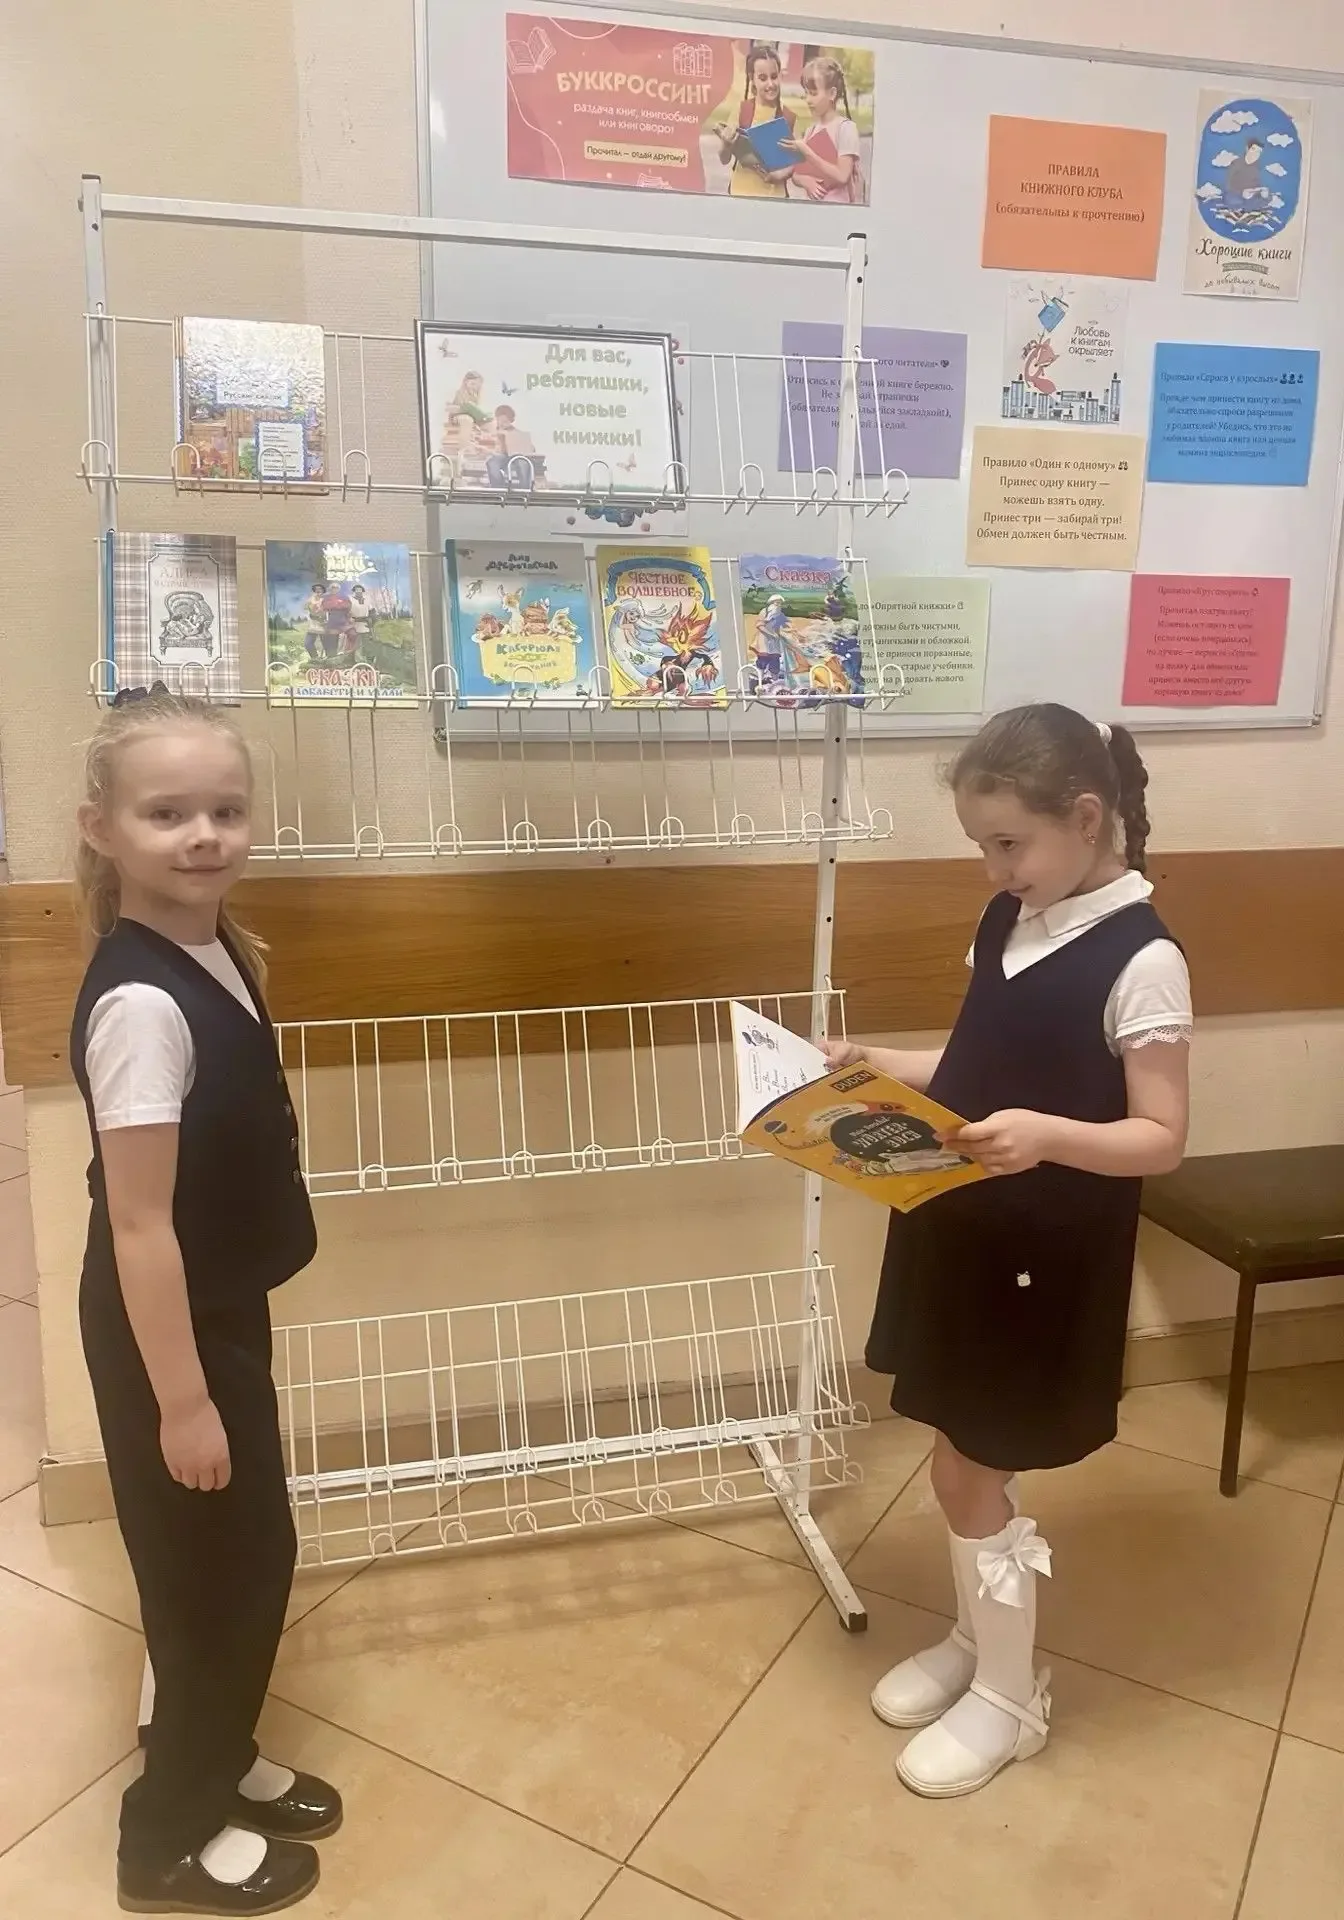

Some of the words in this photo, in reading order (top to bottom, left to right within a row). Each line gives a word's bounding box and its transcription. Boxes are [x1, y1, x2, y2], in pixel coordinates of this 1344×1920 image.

[556, 71, 712, 105] БУККРОССИНГ
[573, 103, 614, 115] раздача
[615, 107, 639, 118] книг,
[641, 109, 699, 124] книгообмен
[599, 120, 617, 128] или
[586, 145, 623, 157] Прочитал
[631, 150, 652, 160] отдай
[652, 152, 686, 163] другому!
[1048, 164, 1100, 178] ПРАВИЛА
[1020, 182, 1084, 197] КНИЖНОГО
[1087, 186, 1124, 200] КЛУБА
[995, 202, 1070, 218] (обязательны
[1072, 210, 1079, 219] к
[1082, 209, 1145, 223] прочтению)
[1195, 238, 1253, 264] Хорошие
[1257, 247, 1293, 261] книги
[1074, 326, 1111, 338] Любовь
[1078, 338, 1111, 347] книгам
[545, 343, 587, 364] Для
[592, 347, 632, 367] вас,
[526, 370, 649, 394] ребятишки,
[821, 389, 832, 398] Не
[559, 404, 627, 418] новые
[553, 429, 642, 447] книжки!
[983, 457, 1027, 469] Правило
[1029, 457, 1062, 470] «Один
[1064, 460, 1071, 469] к
[1073, 461, 1116, 472] одному»
[1000, 476, 1038, 488] Принес
[1039, 479, 1065, 490] одну
[1066, 479, 1097, 491] книгу
[1003, 496, 1045, 505] можешь
[1047, 497, 1077, 506] взять
[1078, 498, 1105, 508] одну.
[983, 512, 1021, 524] Принес
[1023, 515, 1041, 525] три
[1057, 513, 1099, 525] забирай
[1100, 515, 1122, 526] три!
[976, 528, 1009, 539] Обмен
[1011, 530, 1050, 540] должен
[1053, 529, 1079, 540] быть
[1081, 532, 1127, 541] честным.
[628, 571, 686, 585] ЧЕСТНОЕ
[617, 586, 697, 598] ВОЛШЕБНОЕ
[919, 602, 955, 611] книжки»
[862, 624, 896, 632] дожны
[898, 622, 920, 631] быть
[922, 623, 960, 631] чистыми,
[886, 651, 922, 659] приноси
[901, 664, 931, 673] старые
[306, 668, 382, 687] СКАЗКИ
[834, 1071, 872, 1091] DUDEN
